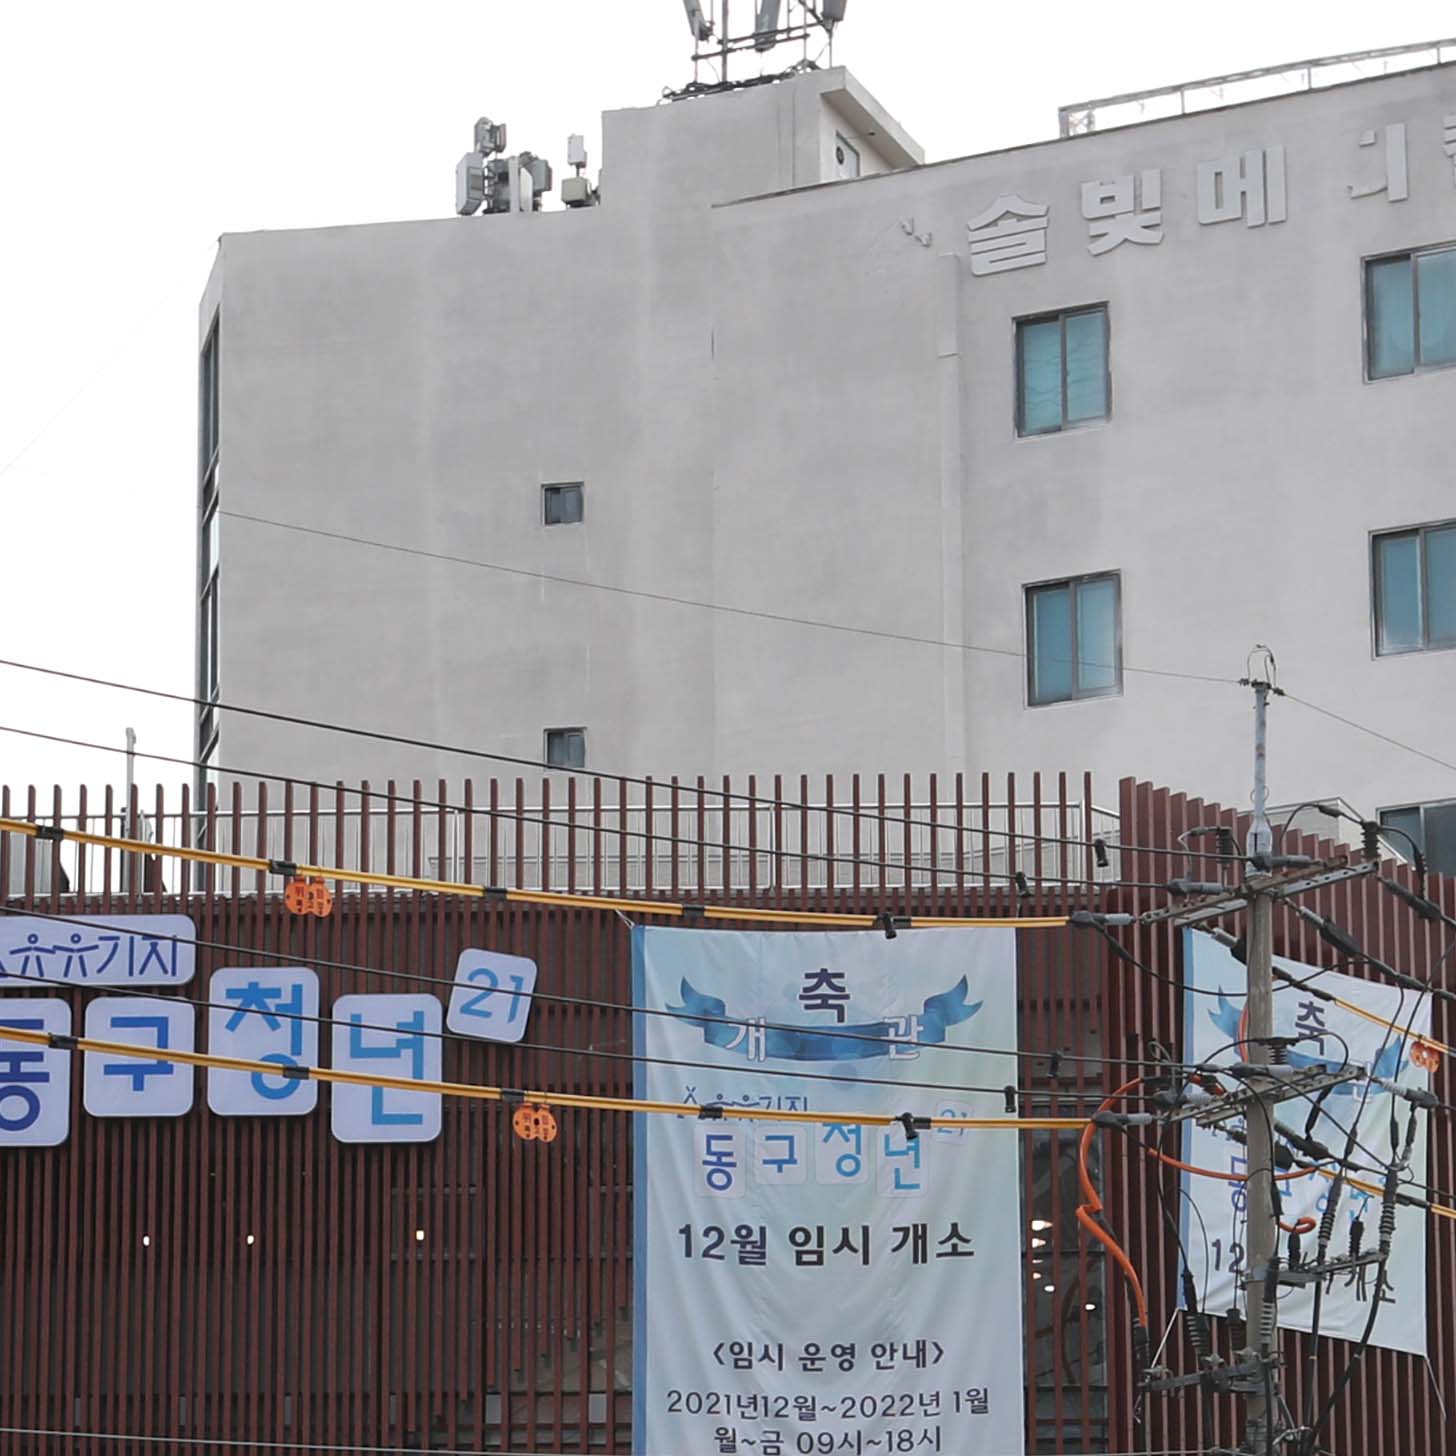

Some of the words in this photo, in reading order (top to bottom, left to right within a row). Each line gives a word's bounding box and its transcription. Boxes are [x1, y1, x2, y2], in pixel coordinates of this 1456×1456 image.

[458, 966, 525, 1024] 21
[798, 967, 851, 1024] 축
[678, 1222, 768, 1266] 12월
[788, 1224, 872, 1266] 임시
[890, 1221, 976, 1266] 개소
[798, 1342, 857, 1372] 운영
[952, 1387, 991, 1415] 1월
[713, 1426, 786, 1456] 월~금
[795, 1425, 943, 1456] 09시~18시
